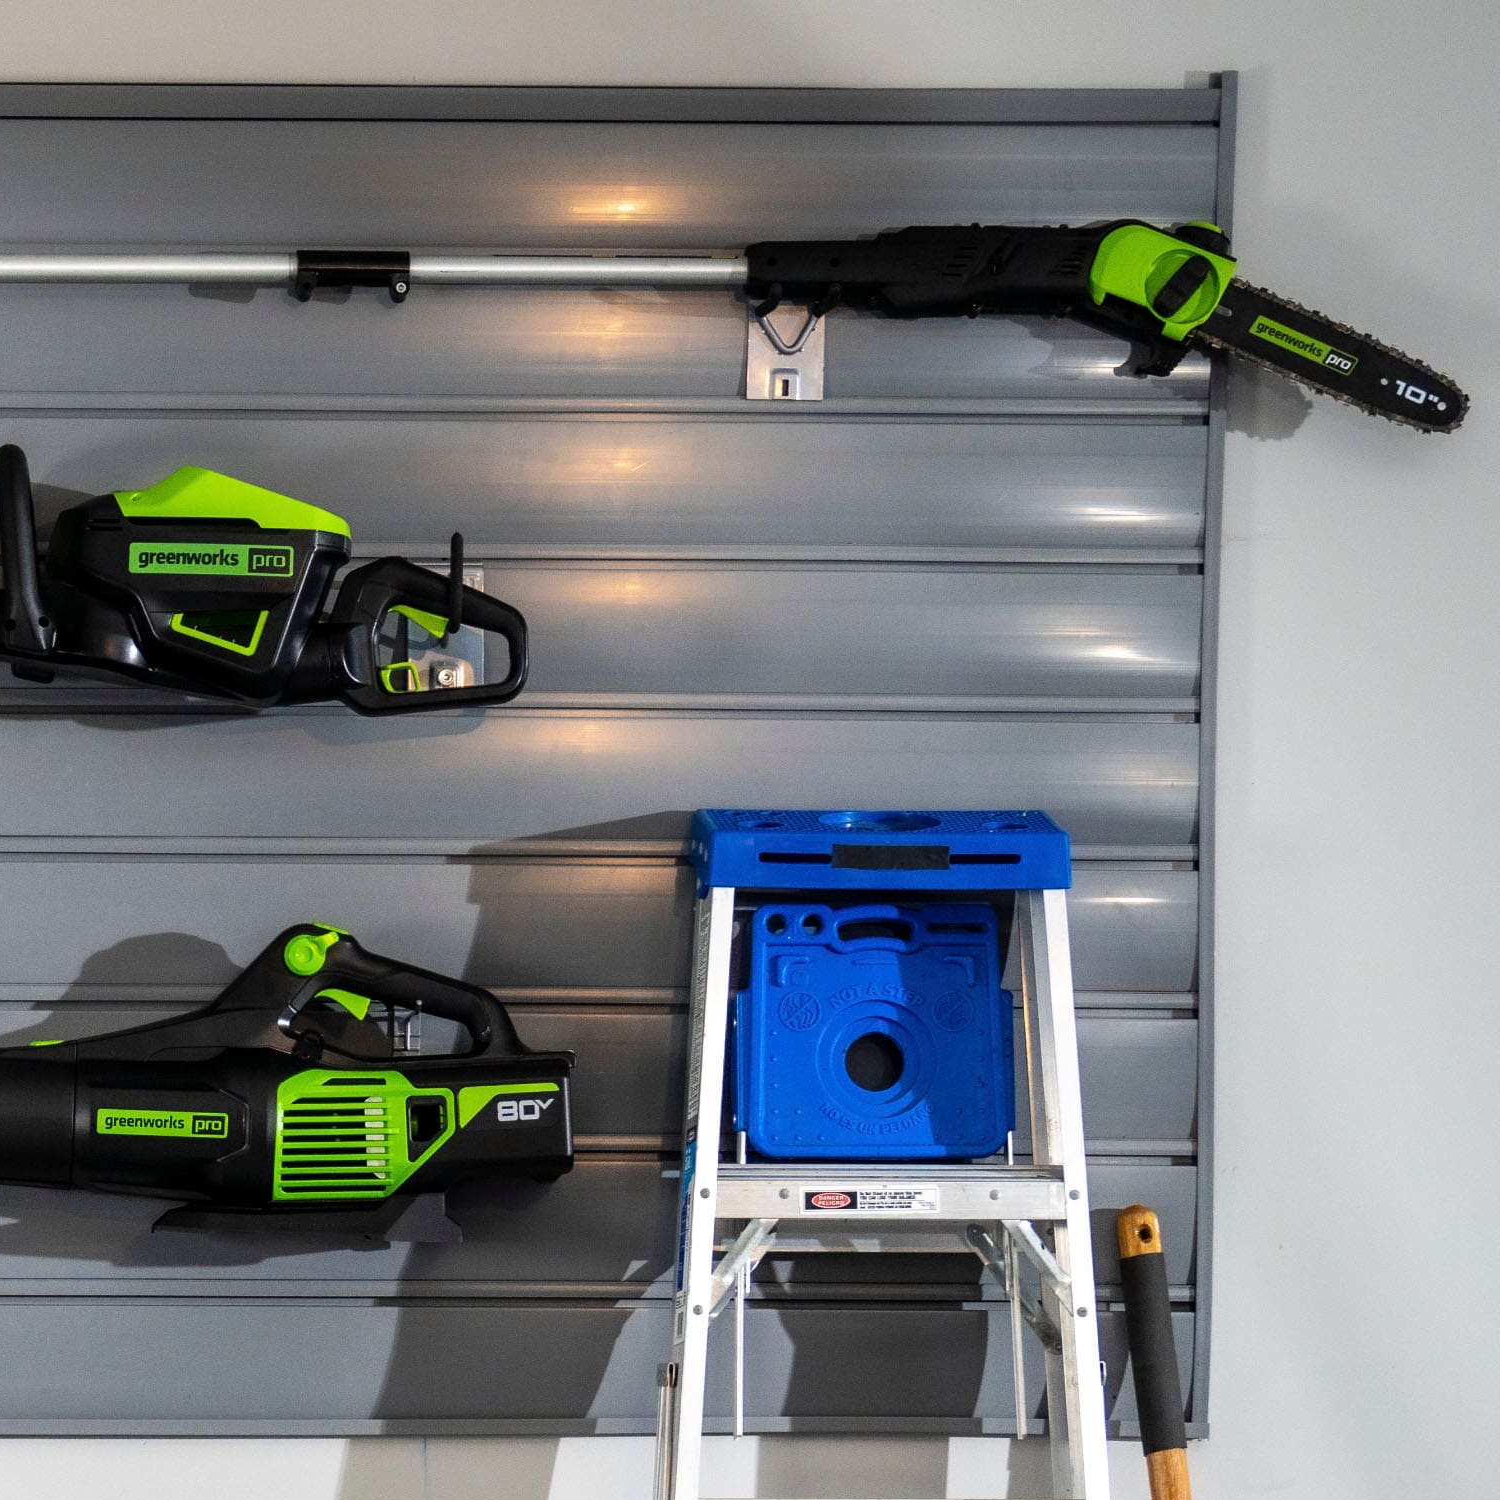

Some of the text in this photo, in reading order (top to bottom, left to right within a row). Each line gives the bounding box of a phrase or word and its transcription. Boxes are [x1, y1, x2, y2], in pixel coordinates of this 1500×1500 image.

[1256, 322, 1352, 370] greenworks pro
[1395, 379, 1439, 405] 10"
[138, 549, 286, 570] greenworks pro
[828, 982, 925, 1010] NOT A STEP
[105, 1116, 222, 1133] greenworks pro
